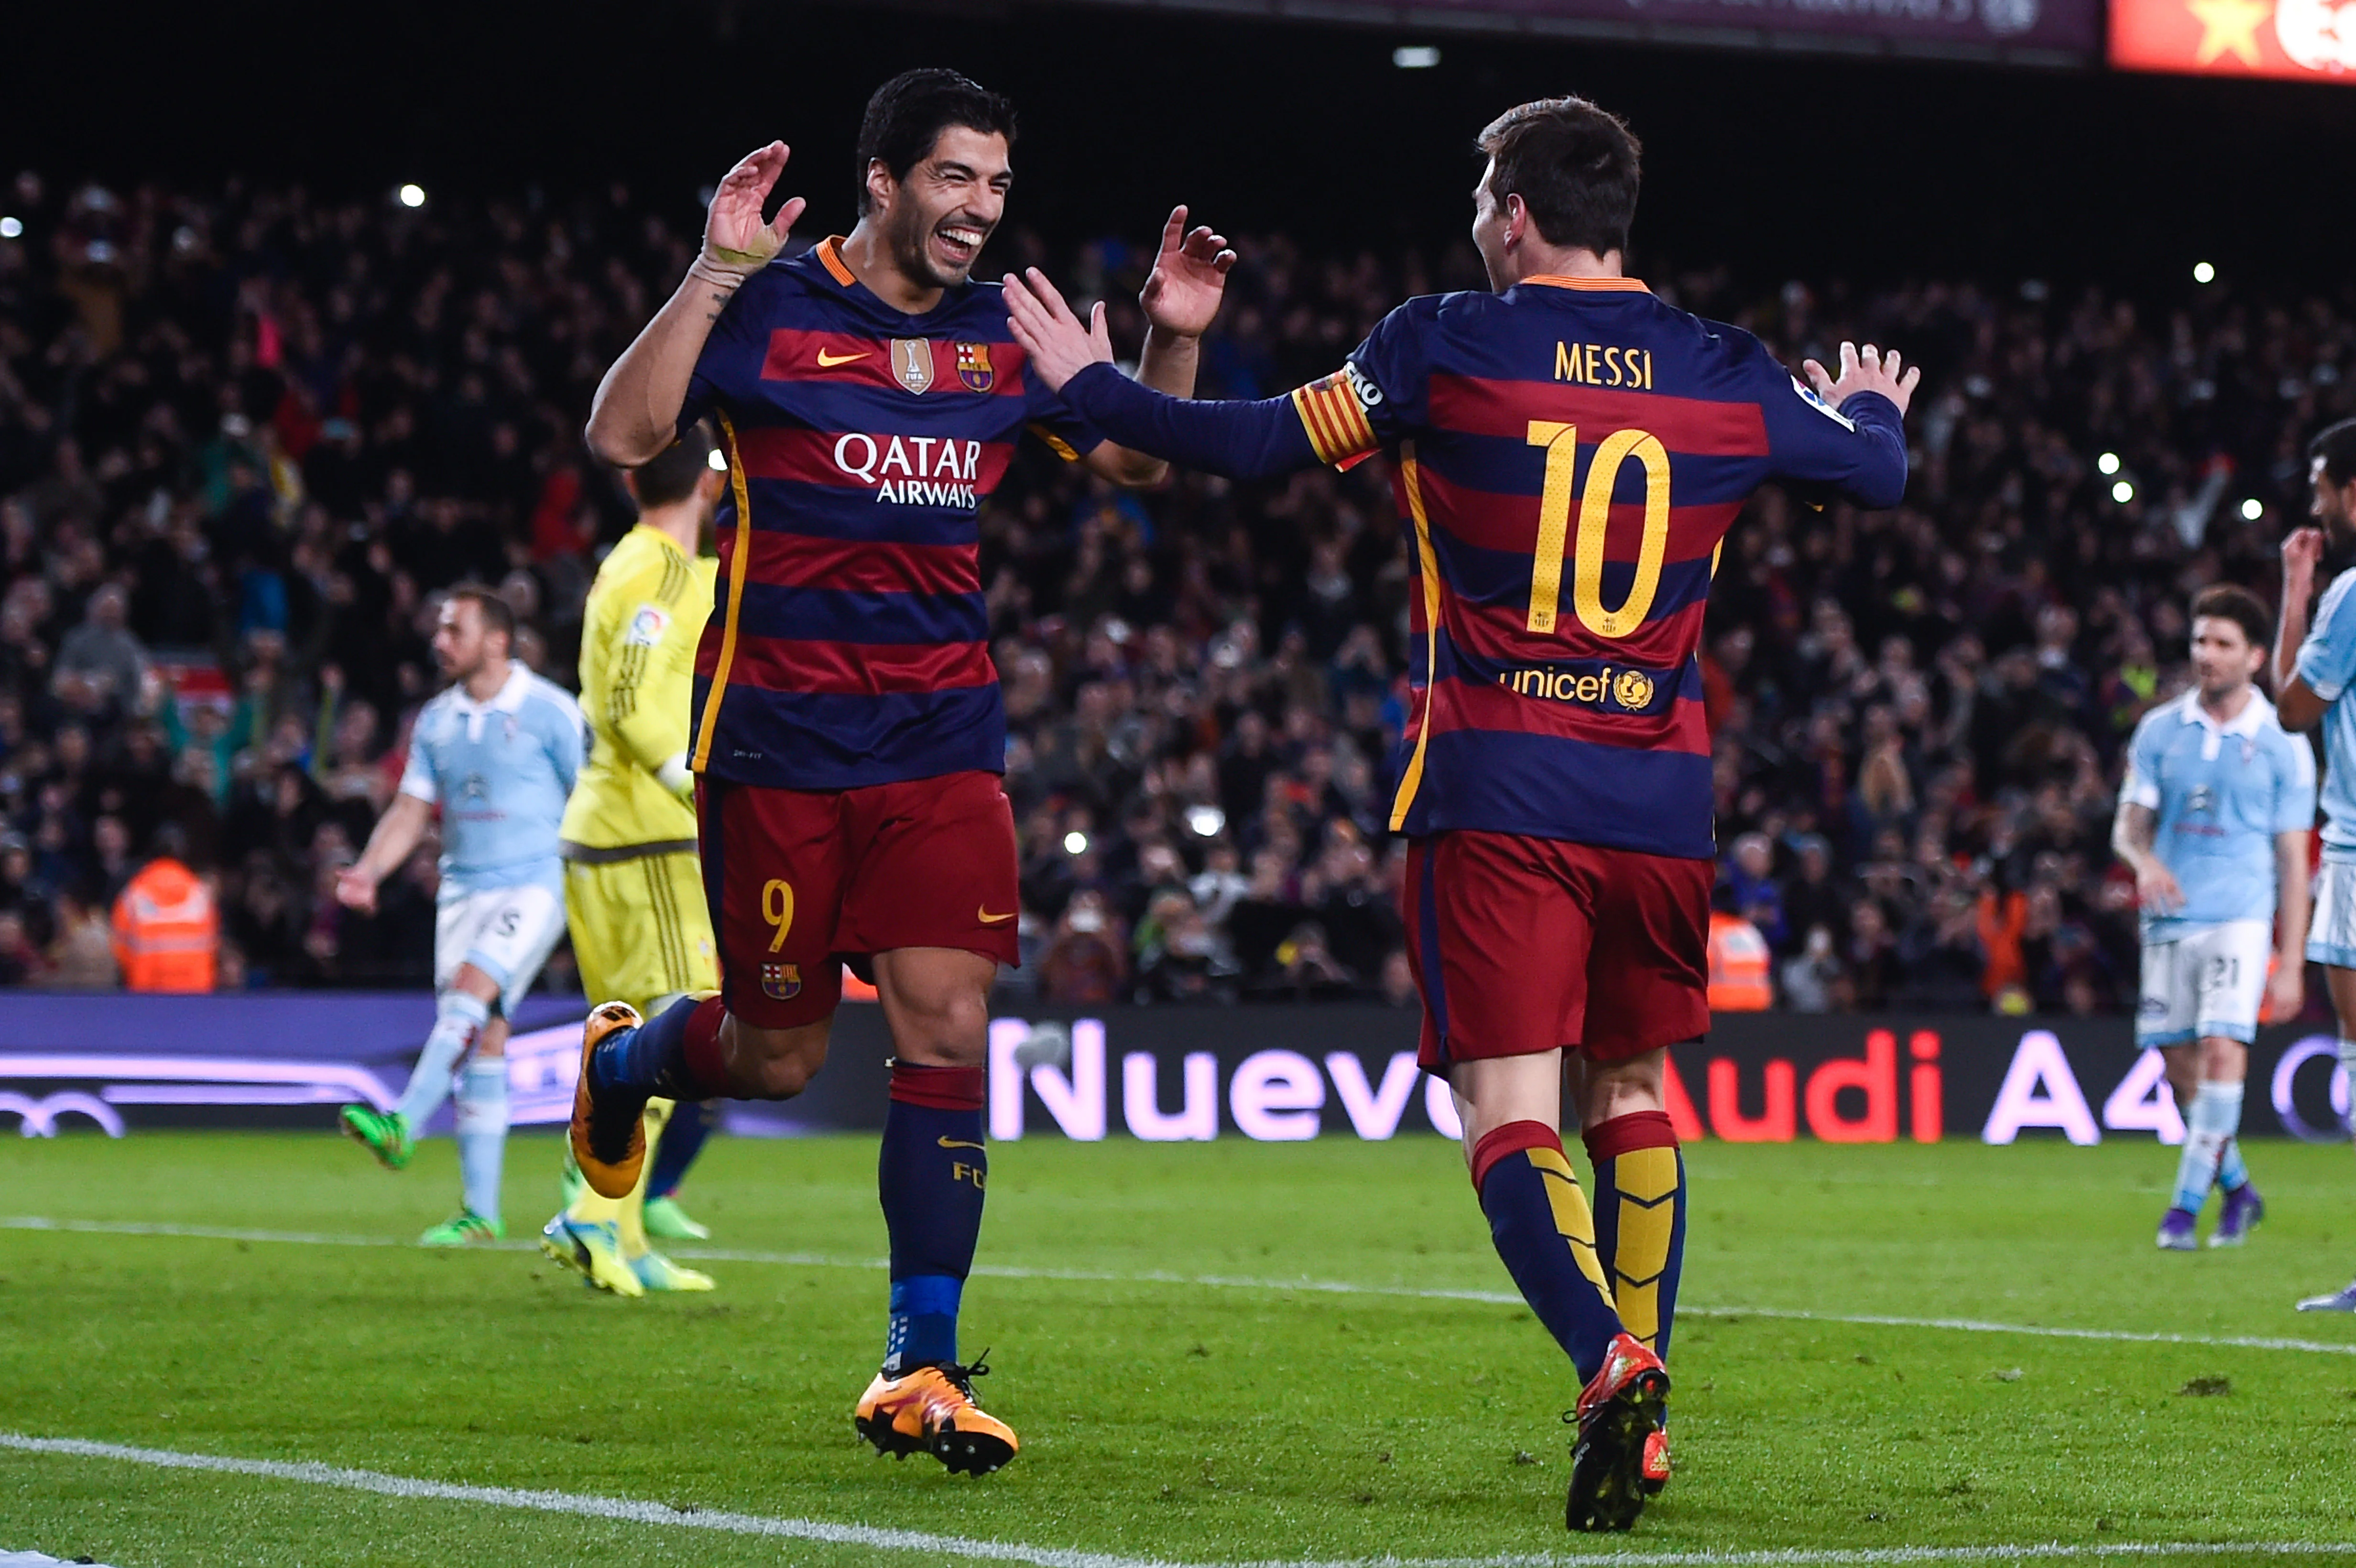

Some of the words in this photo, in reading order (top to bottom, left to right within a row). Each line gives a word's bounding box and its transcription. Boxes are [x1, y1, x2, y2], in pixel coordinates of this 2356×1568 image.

[1554, 341, 1652, 390] MESSI
[834, 433, 981, 484] QATAR
[876, 478, 976, 510] AIRWAYS
[1527, 419, 1671, 638] 10
[762, 879, 795, 953] 9
[2210, 956, 2239, 990] 21
[1982, 1029, 2188, 1144] A4
